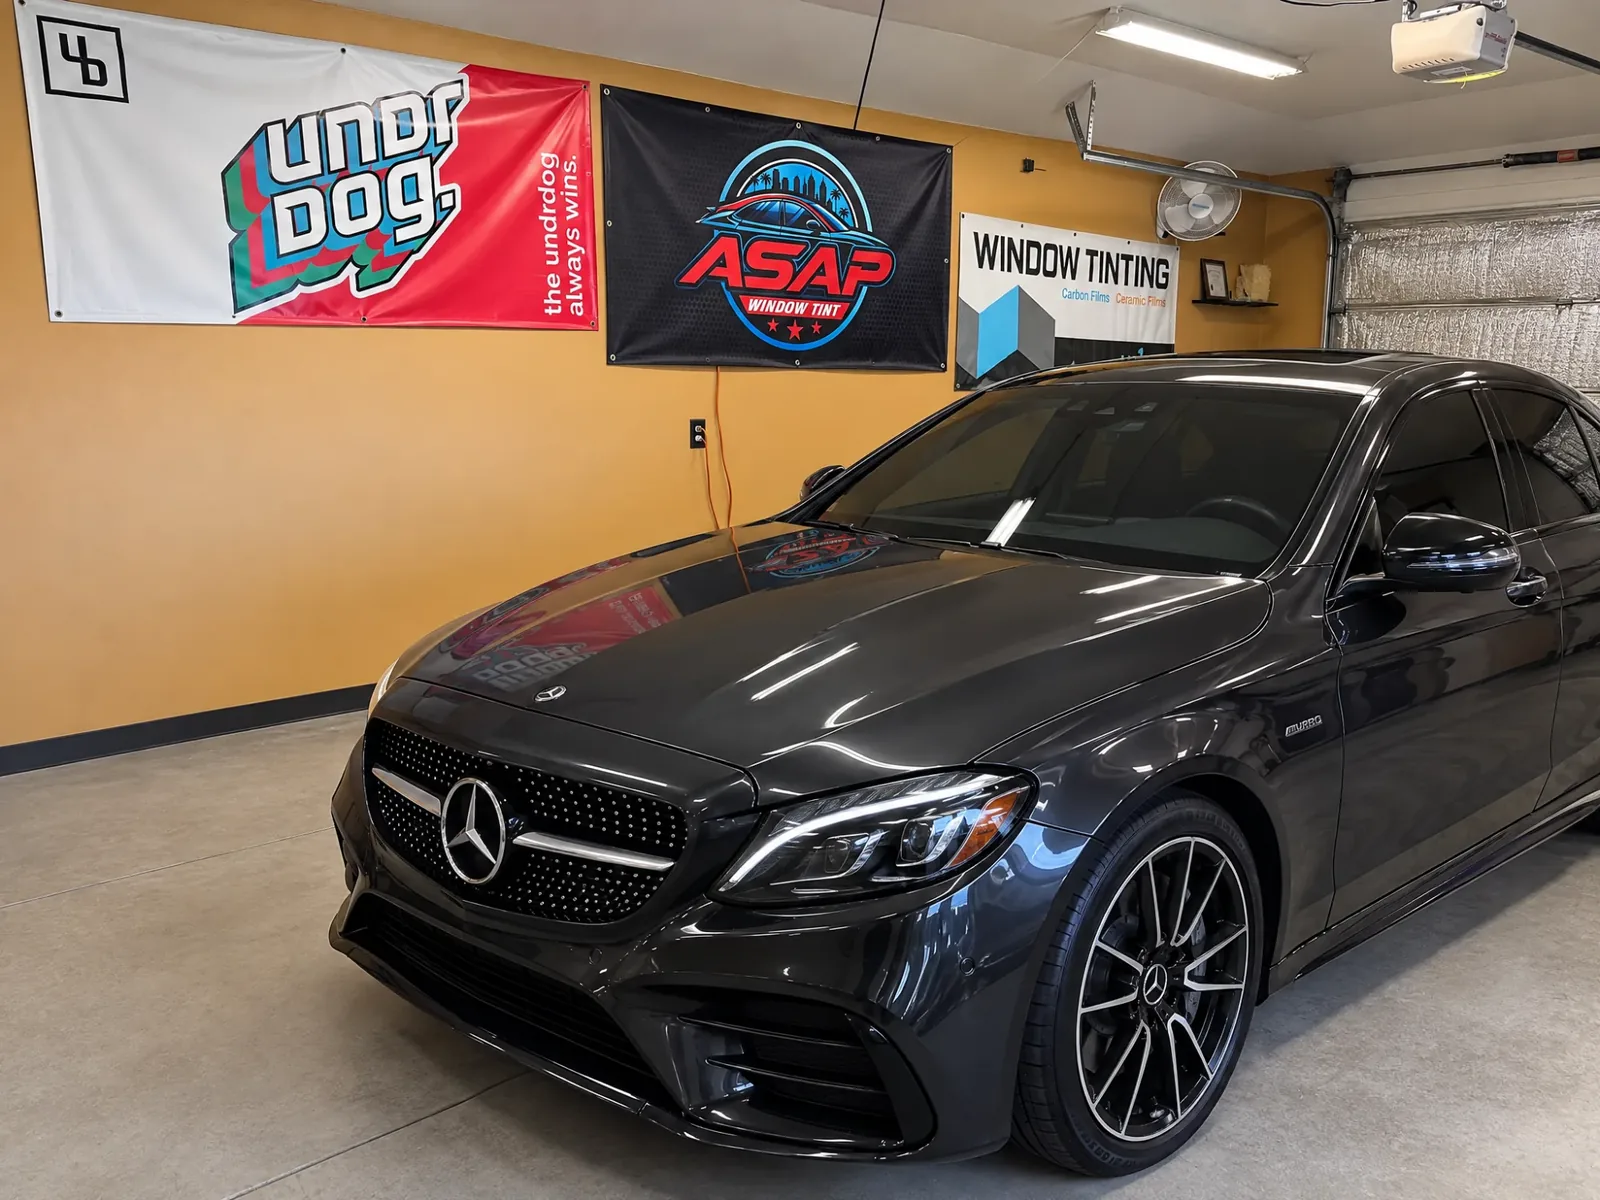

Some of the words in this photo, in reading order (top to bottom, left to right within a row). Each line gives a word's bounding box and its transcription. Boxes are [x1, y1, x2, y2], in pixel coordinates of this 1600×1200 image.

[538, 152, 560, 265] undrdog
[560, 155, 579, 220] wins.
[566, 227, 585, 316] always
[679, 235, 893, 296] ASAP
[973, 231, 1080, 281] WINDOW
[1085, 248, 1170, 290] TINTING
[544, 273, 561, 315] the
[748, 298, 809, 315] WINDOW
[811, 303, 841, 317] TINT
[1061, 287, 1089, 301] Carbon
[1091, 290, 1110, 303] Films
[1115, 293, 1146, 306] Ceramic
[1147, 295, 1166, 308] Films
